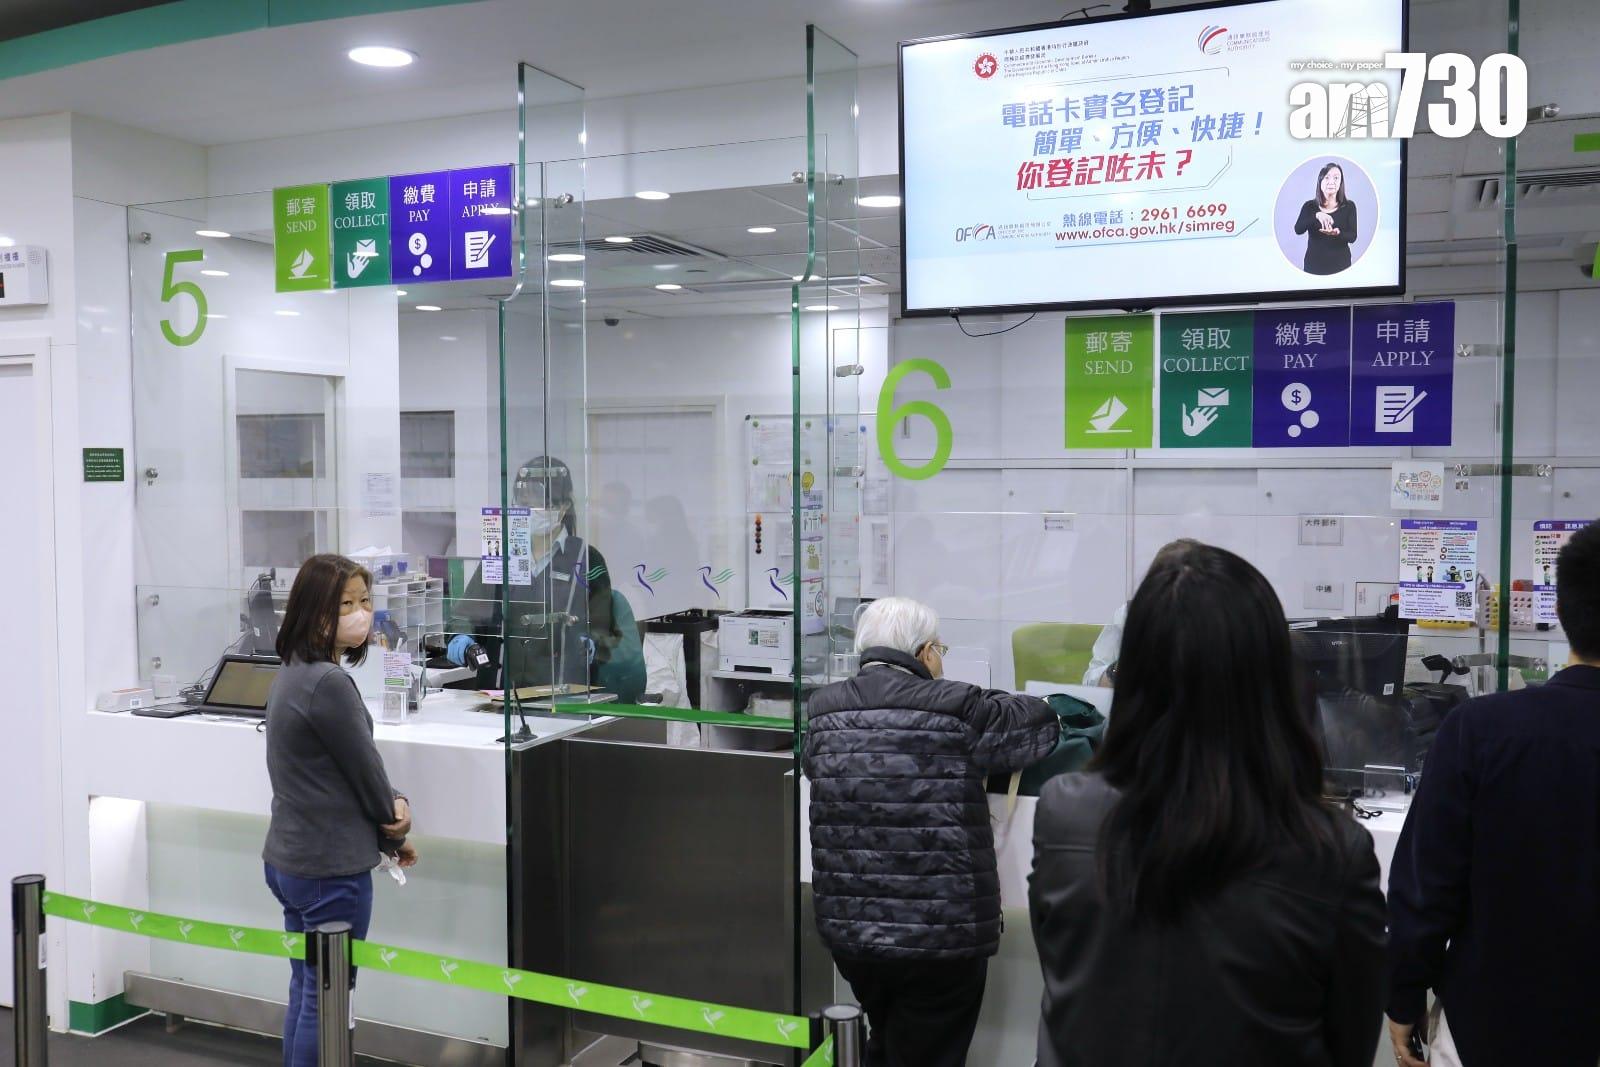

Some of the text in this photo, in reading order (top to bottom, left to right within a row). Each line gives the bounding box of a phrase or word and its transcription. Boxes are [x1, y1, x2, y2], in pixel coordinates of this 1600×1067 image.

[1001, 85, 1194, 128] 電話卡實名登記
[403, 184, 436, 205] 繳費
[463, 178, 496, 200] 申請
[286, 197, 317, 217] 郵寄
[345, 191, 376, 211] 領取
[334, 213, 388, 229] COLLECT
[408, 208, 431, 223] PAY
[1141, 206, 1179, 222] 2961
[1186, 203, 1227, 218] 6699
[286, 220, 317, 234] SEND
[1055, 219, 1235, 241] www.ofca.gov.hk/simreg
[159, 249, 208, 347] 5
[1085, 330, 1133, 354] 郵寄
[1181, 327, 1231, 351] 領取
[1275, 321, 1327, 346] 繳費
[1376, 319, 1431, 345] 申請
[1084, 359, 1133, 376] SEND
[1163, 356, 1250, 374] COLLECT
[1283, 353, 1318, 369] PAY
[1372, 350, 1434, 368] APPLY
[876, 358, 953, 480] 6
